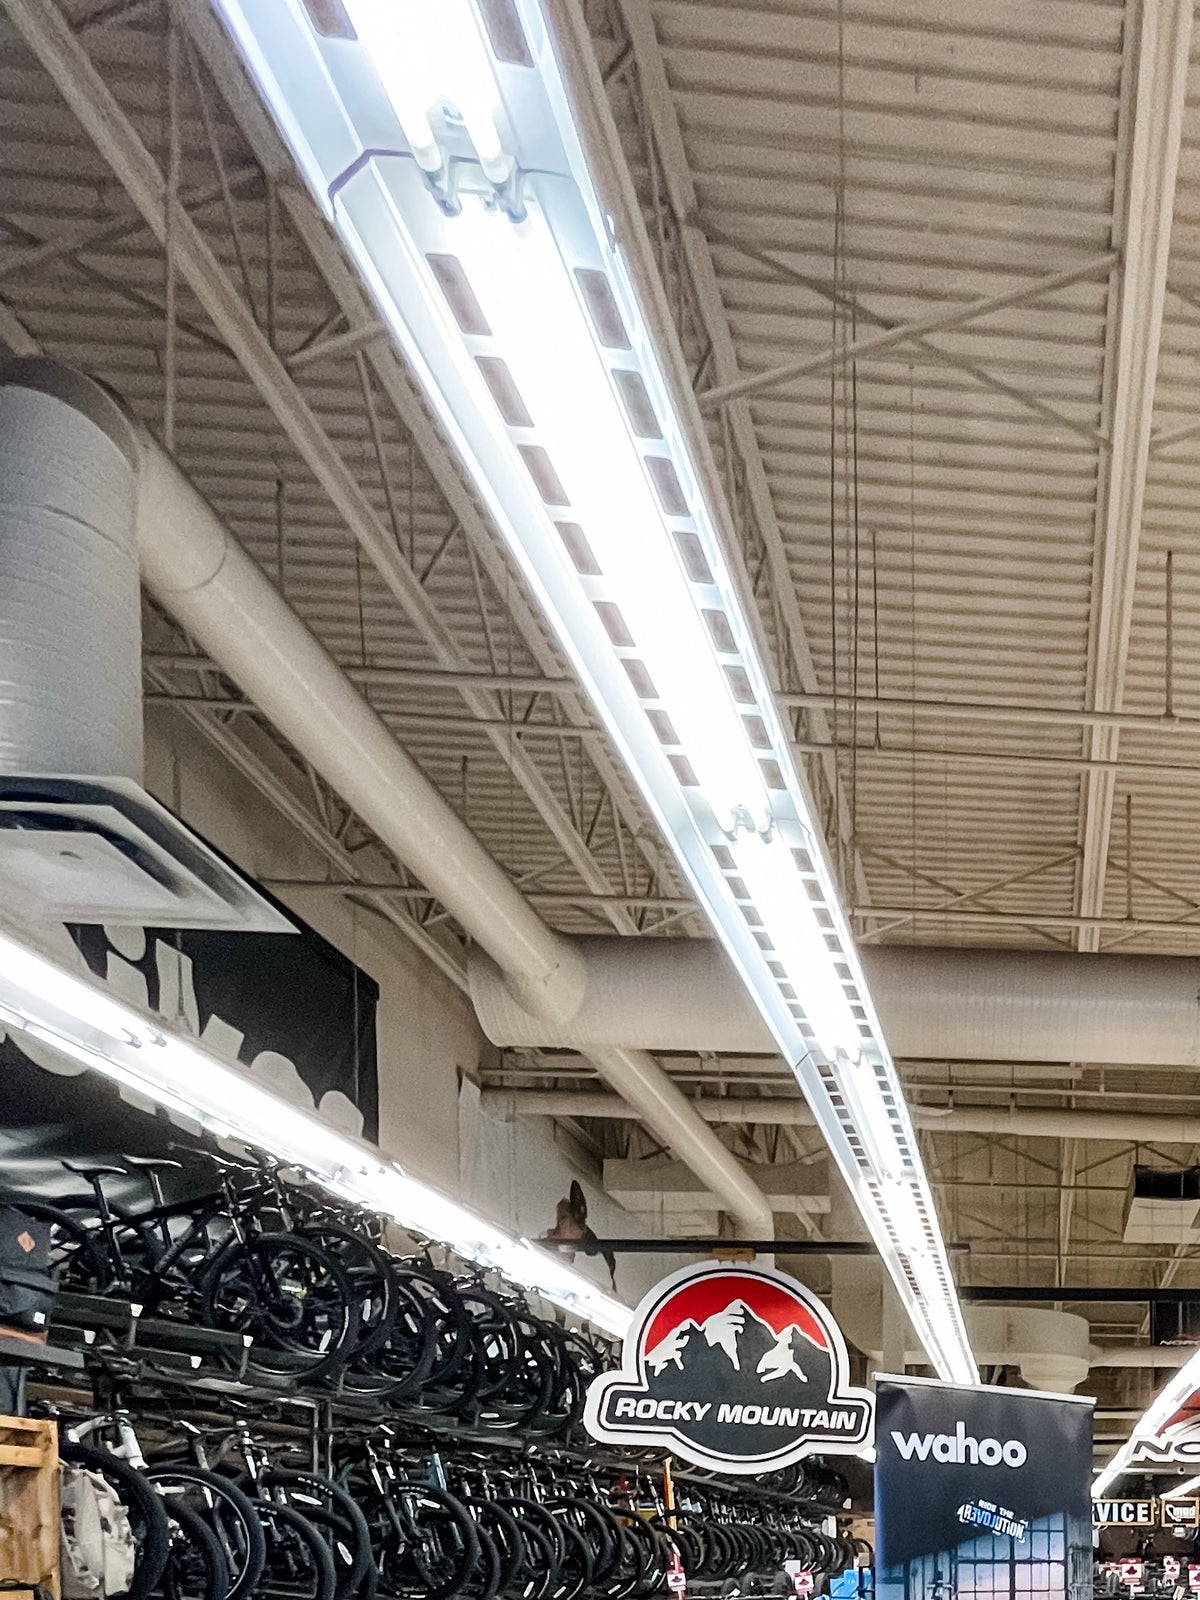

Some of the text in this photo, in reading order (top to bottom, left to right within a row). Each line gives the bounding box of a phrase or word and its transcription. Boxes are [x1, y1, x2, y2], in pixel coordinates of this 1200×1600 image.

[614, 1397, 857, 1431] ROCKY MOUNTAIN
[890, 1420, 1027, 1468] wahoo
[978, 1499, 1015, 1519] RIDE THE
[1092, 1502, 1150, 1523] VICE
